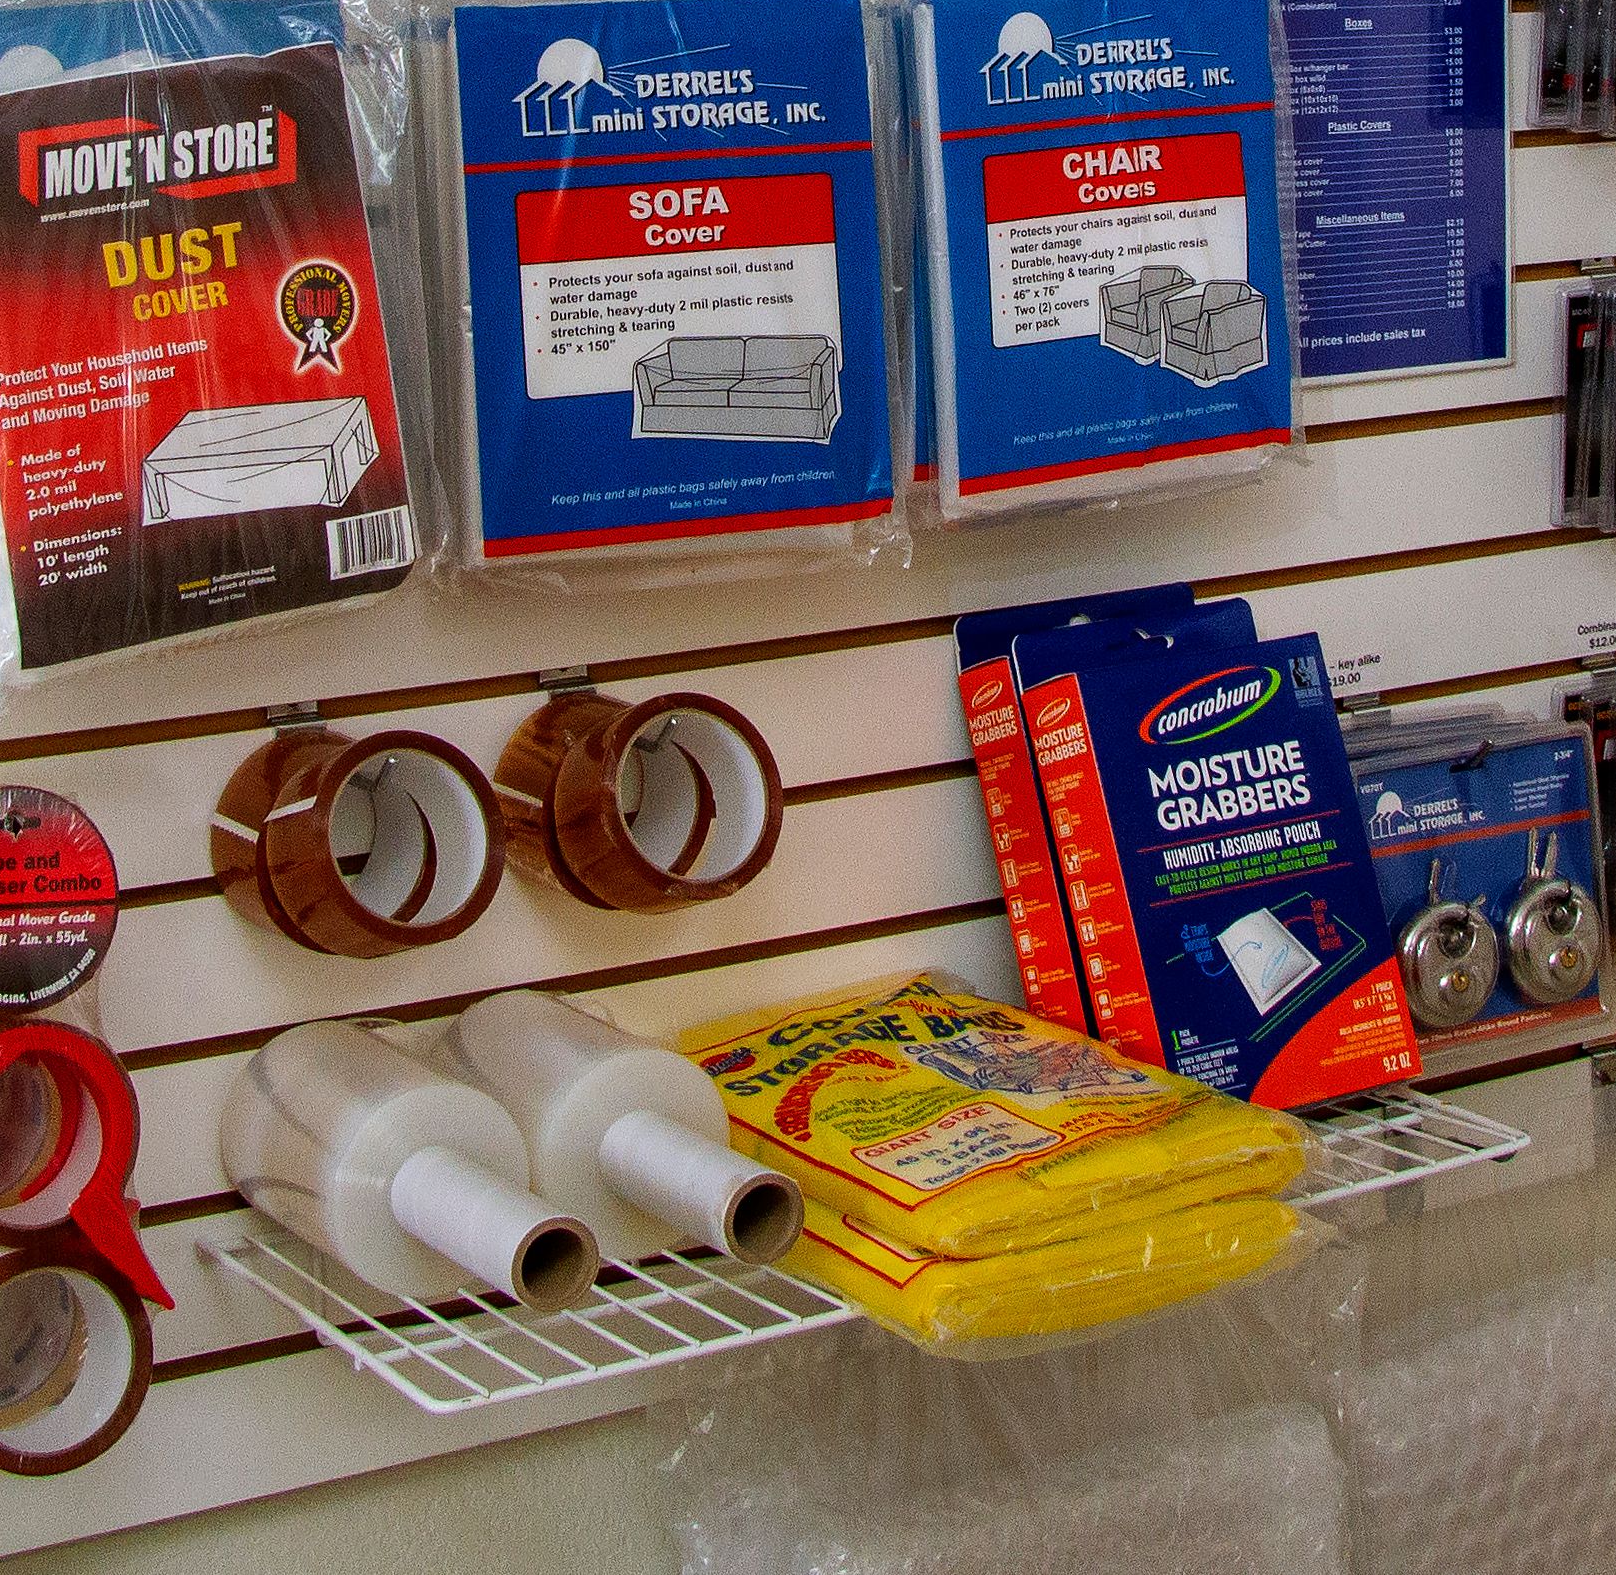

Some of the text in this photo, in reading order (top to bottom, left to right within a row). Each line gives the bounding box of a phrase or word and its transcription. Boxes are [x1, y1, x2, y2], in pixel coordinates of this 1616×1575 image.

[1344, 18, 1373, 28] Boxes
[1076, 37, 1173, 65] DERREL'S
[635, 69, 754, 98] DERREL'S
[1043, 76, 1083, 99] mini
[1202, 65, 1234, 86] INC.
[593, 110, 644, 133] mini
[786, 101, 826, 124] INC.
[1328, 120, 1391, 132] Plastic Covers
[45, 143, 134, 199] MOVE
[172, 117, 274, 180] STORE
[1062, 144, 1162, 179] CHAIR
[629, 187, 729, 220] SOFA
[1078, 180, 1156, 203] Covers
[41, 198, 150, 223] www.movenstore.com
[1316, 211, 1405, 226] Miscellaneous Items
[645, 222, 725, 247] Cover
[103, 222, 243, 290] DUST
[133, 281, 229, 321] COVER
[1014, 299, 1089, 316] Two (2) covers
[1015, 317, 1060, 333] per pack
[1311, 335, 1343, 348] prices
[1346, 331, 1382, 344] include
[1384, 330, 1408, 340] sales
[1412, 328, 1426, 337] tax
[51, 361, 83, 377] Your
[87, 344, 163, 371] Household
[167, 339, 207, 357] Items
[576, 345, 583, 353] x
[0, 385, 53, 410] Against
[58, 380, 96, 398] Dust,
[134, 364, 176, 382] Water
[1, 391, 149, 430] and Moving Damage
[1338, 654, 1381, 670] key alike
[968, 705, 1014, 731] MOISTURE
[1156, 676, 1262, 736] concrobium
[972, 720, 1018, 746] GRABBERS
[1034, 723, 1084, 751] MOISTURE
[1037, 738, 1087, 766] GRABBERS
[1148, 740, 1304, 799] MOISTURE
[1157, 772, 1310, 831] GRABBERS
[1397, 821, 1417, 834] mini
[1163, 821, 1321, 870] HUMIDITY-ABSORBING POUCH
[24, 852, 60, 869] and
[34, 874, 102, 893] Combo
[18, 913, 56, 926] Mover
[59, 911, 96, 924] Grade
[864, 1131, 931, 1157] GIANT
[938, 1106, 991, 1128] SIZE
